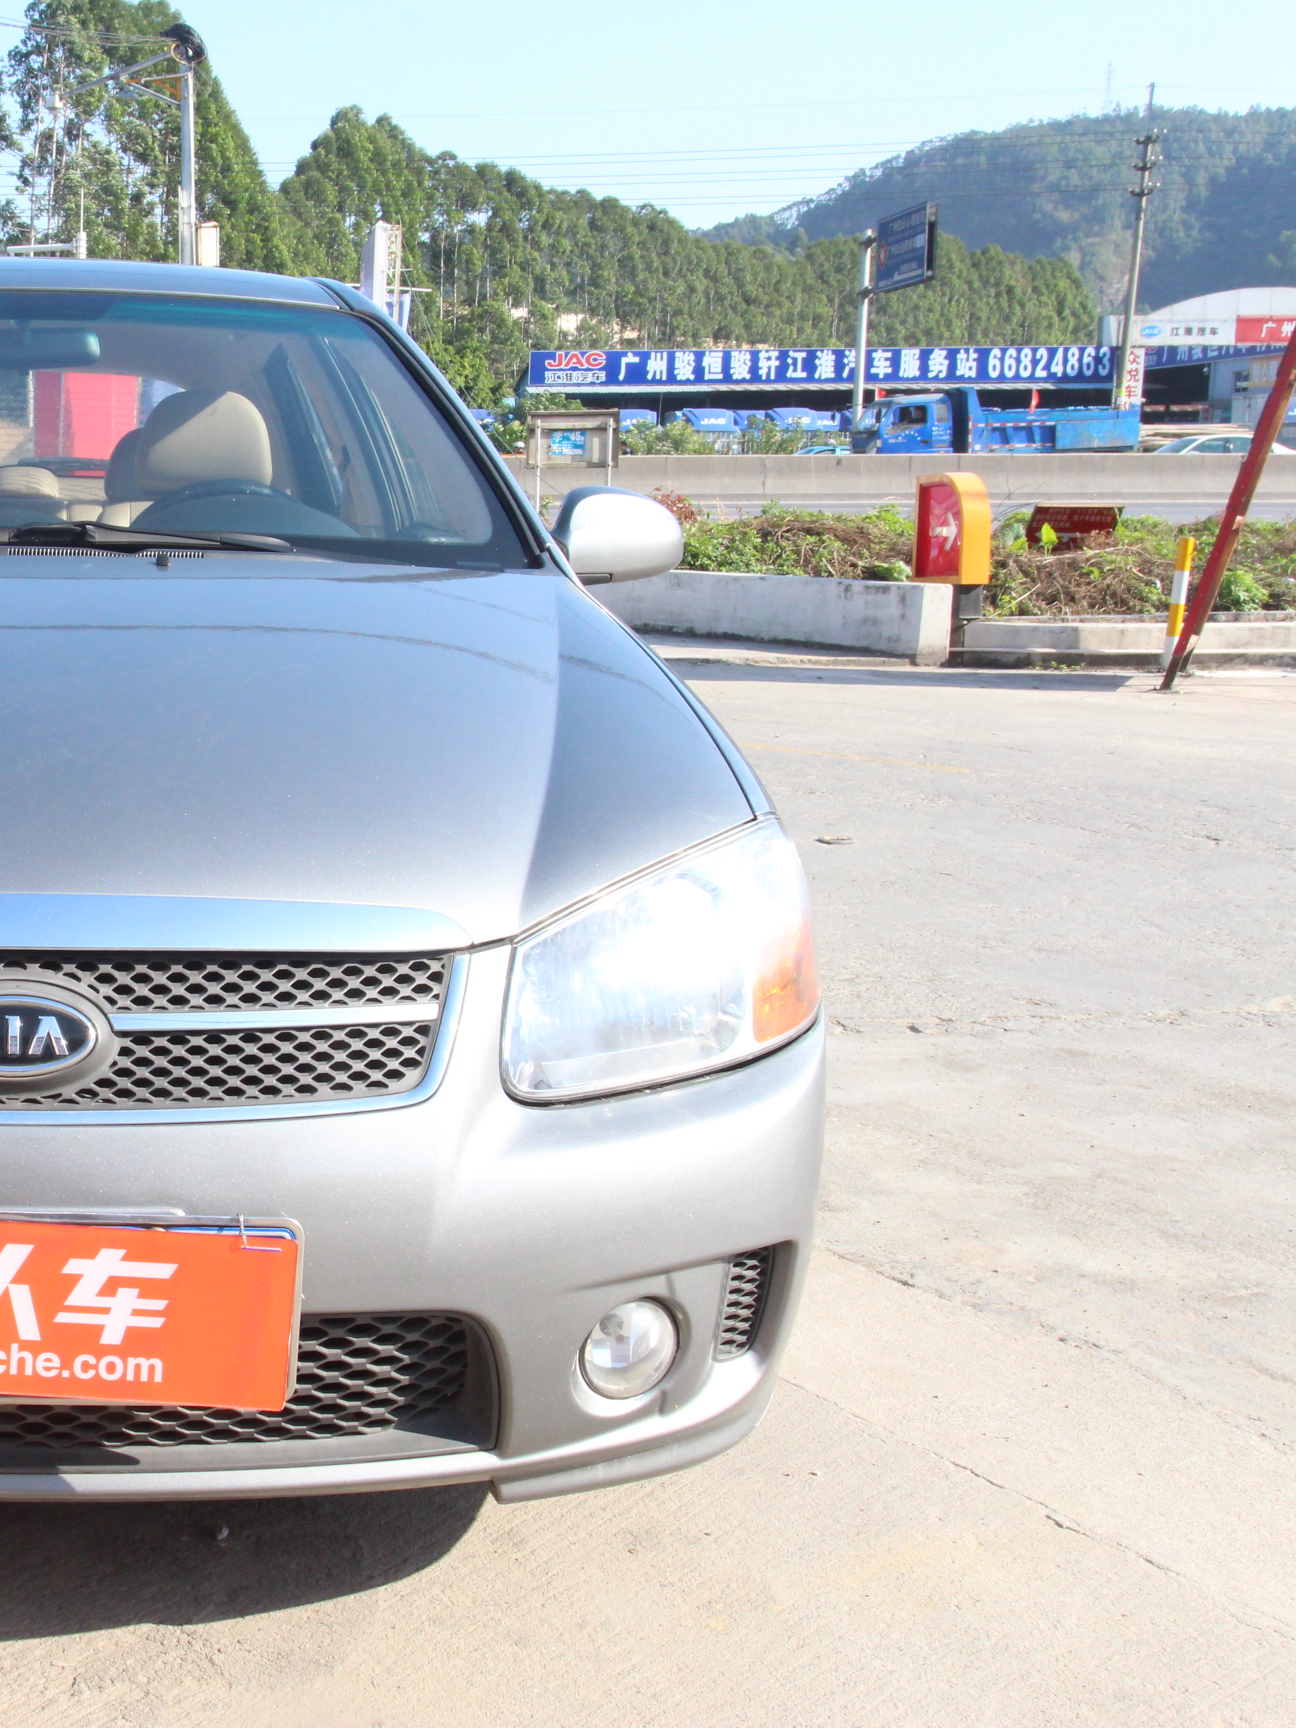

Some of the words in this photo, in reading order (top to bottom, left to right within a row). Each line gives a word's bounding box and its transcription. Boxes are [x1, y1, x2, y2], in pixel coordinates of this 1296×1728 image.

[1169, 326, 1219, 337] 江淮汽车
[545, 351, 606, 369] JAC
[987, 346, 1112, 379] 66824863
[544, 371, 606, 383] 江淮汽车
[700, 417, 727, 425] JAC
